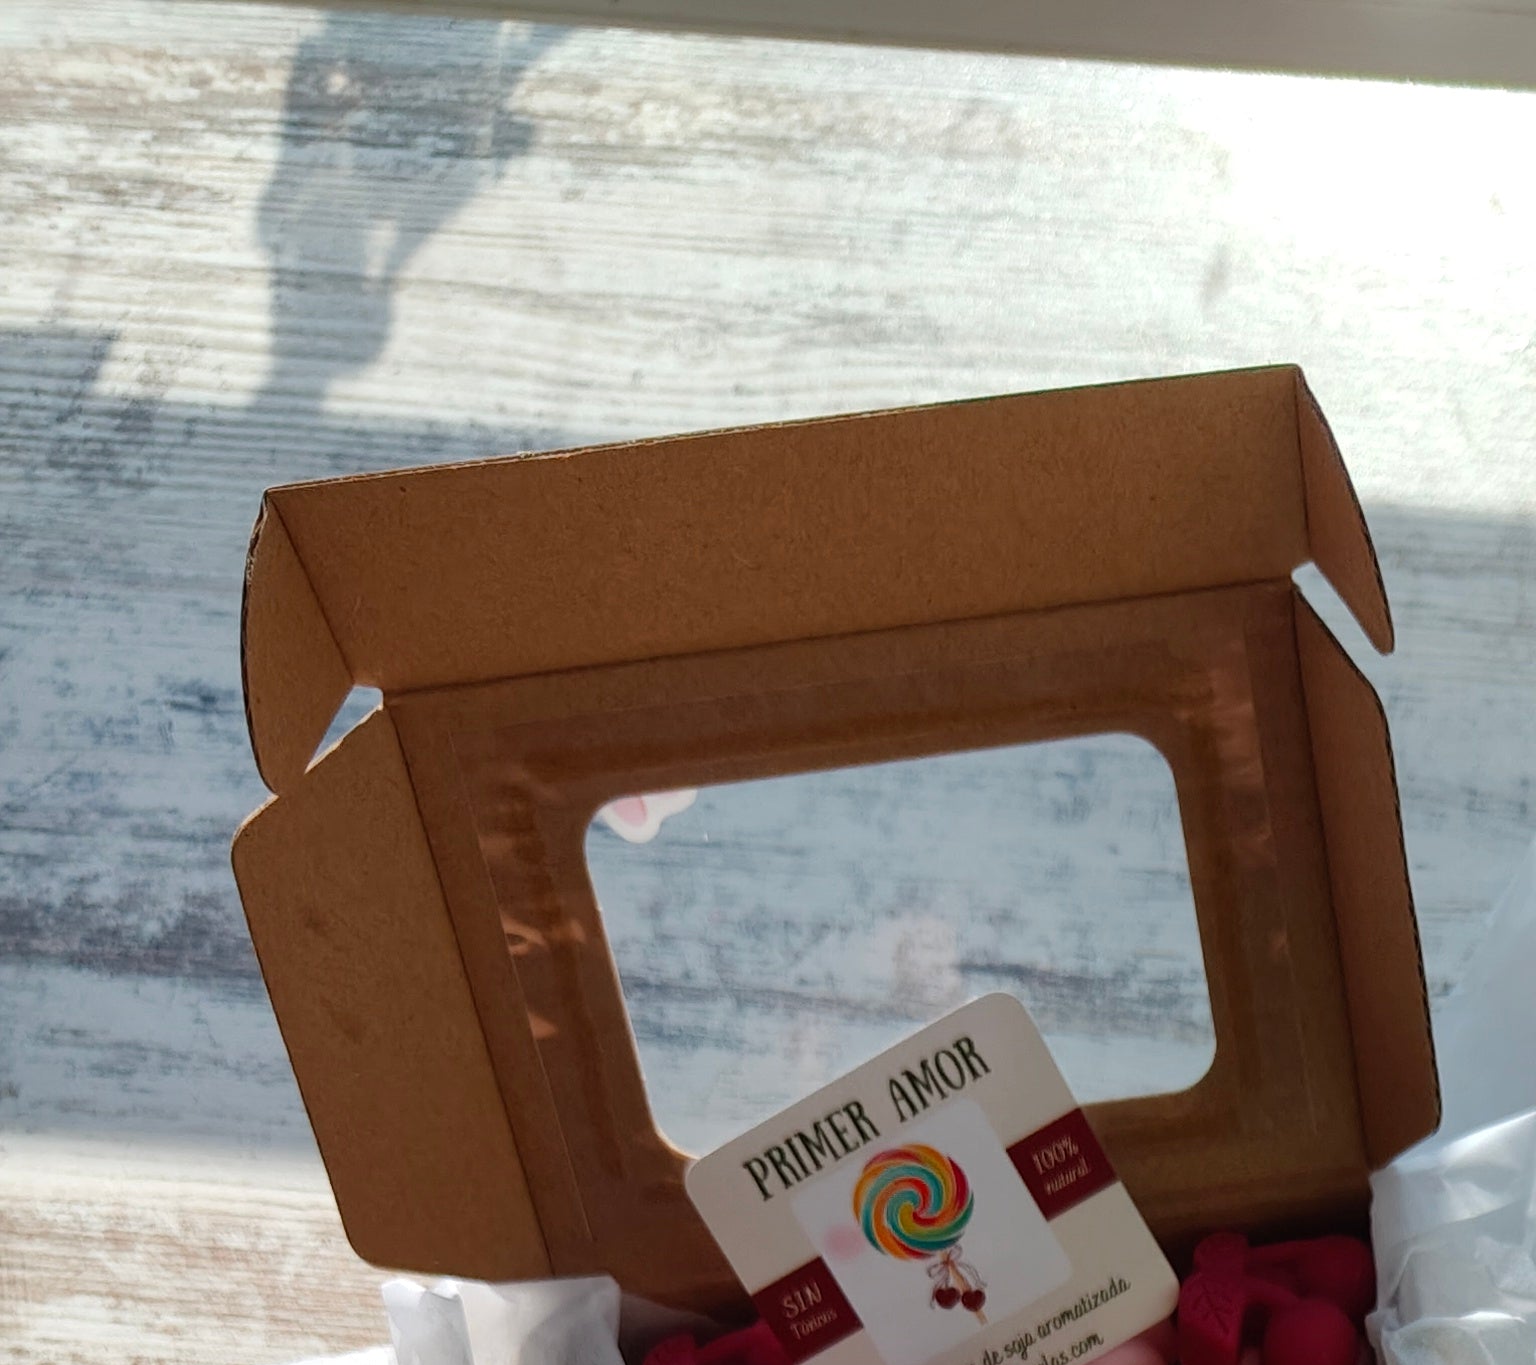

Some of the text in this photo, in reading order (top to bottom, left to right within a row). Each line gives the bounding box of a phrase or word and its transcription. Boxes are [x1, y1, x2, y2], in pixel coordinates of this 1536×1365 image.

[742, 1035, 992, 1201] PRIMER AMOR
[1033, 1136, 1079, 1175] 100%
[1044, 1155, 1091, 1195] natural
[783, 1282, 822, 1318] SIN
[1004, 1331, 1036, 1360] soja
[1037, 1276, 1131, 1339] aromatizada
